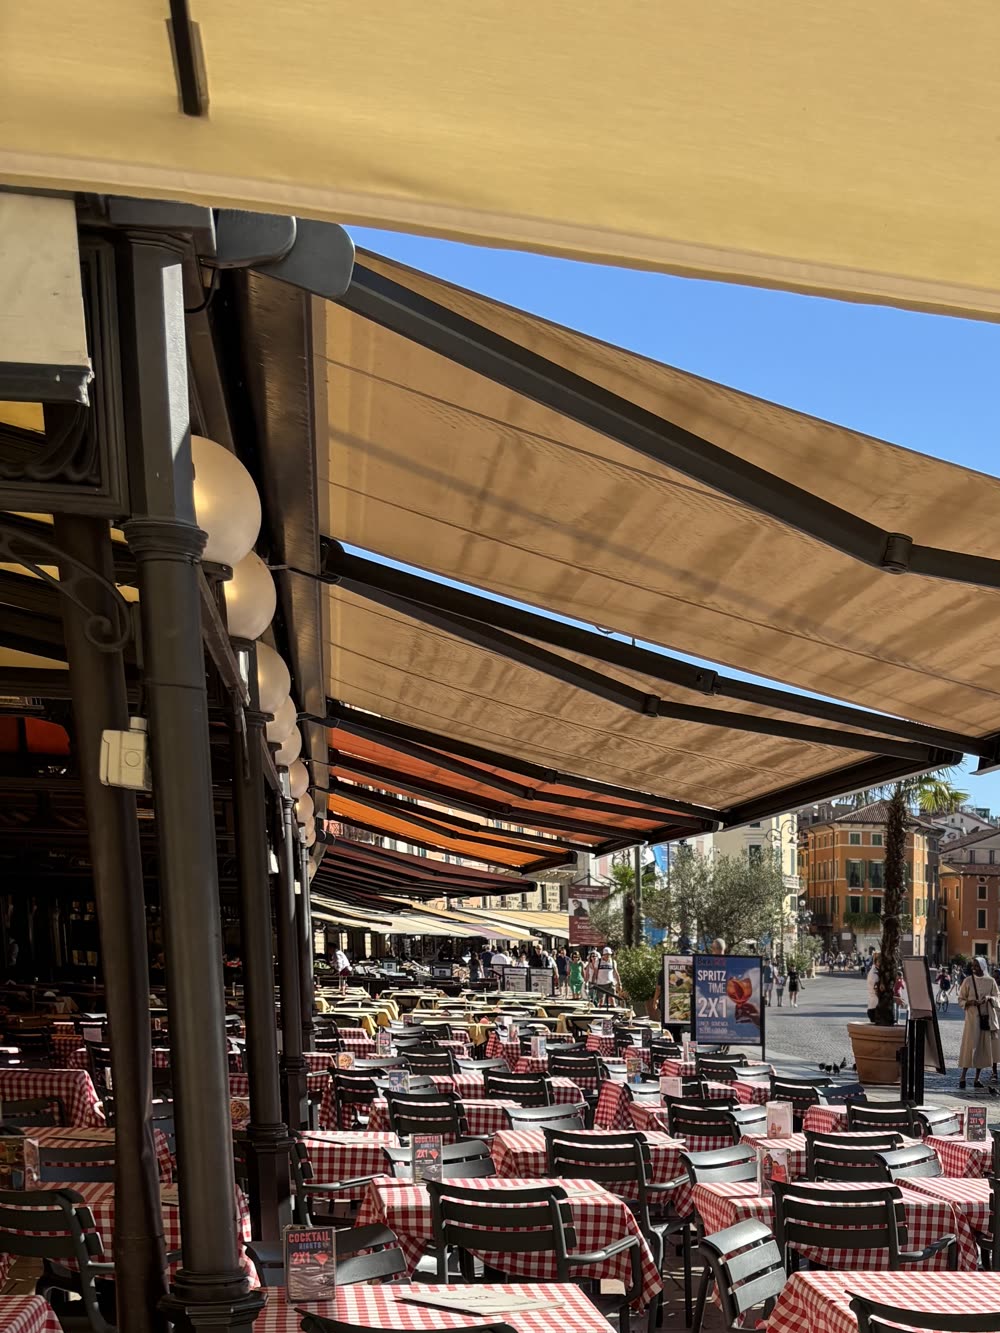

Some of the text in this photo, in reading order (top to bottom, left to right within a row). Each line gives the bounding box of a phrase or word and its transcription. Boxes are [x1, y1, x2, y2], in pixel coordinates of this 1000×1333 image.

[697, 969, 727, 982] SPRITZ
[708, 982, 727, 994] TIME
[698, 997, 727, 1018] 2X1
[288, 1231, 330, 1243] COCKTAIL
[292, 1251, 310, 1265] 2X1
